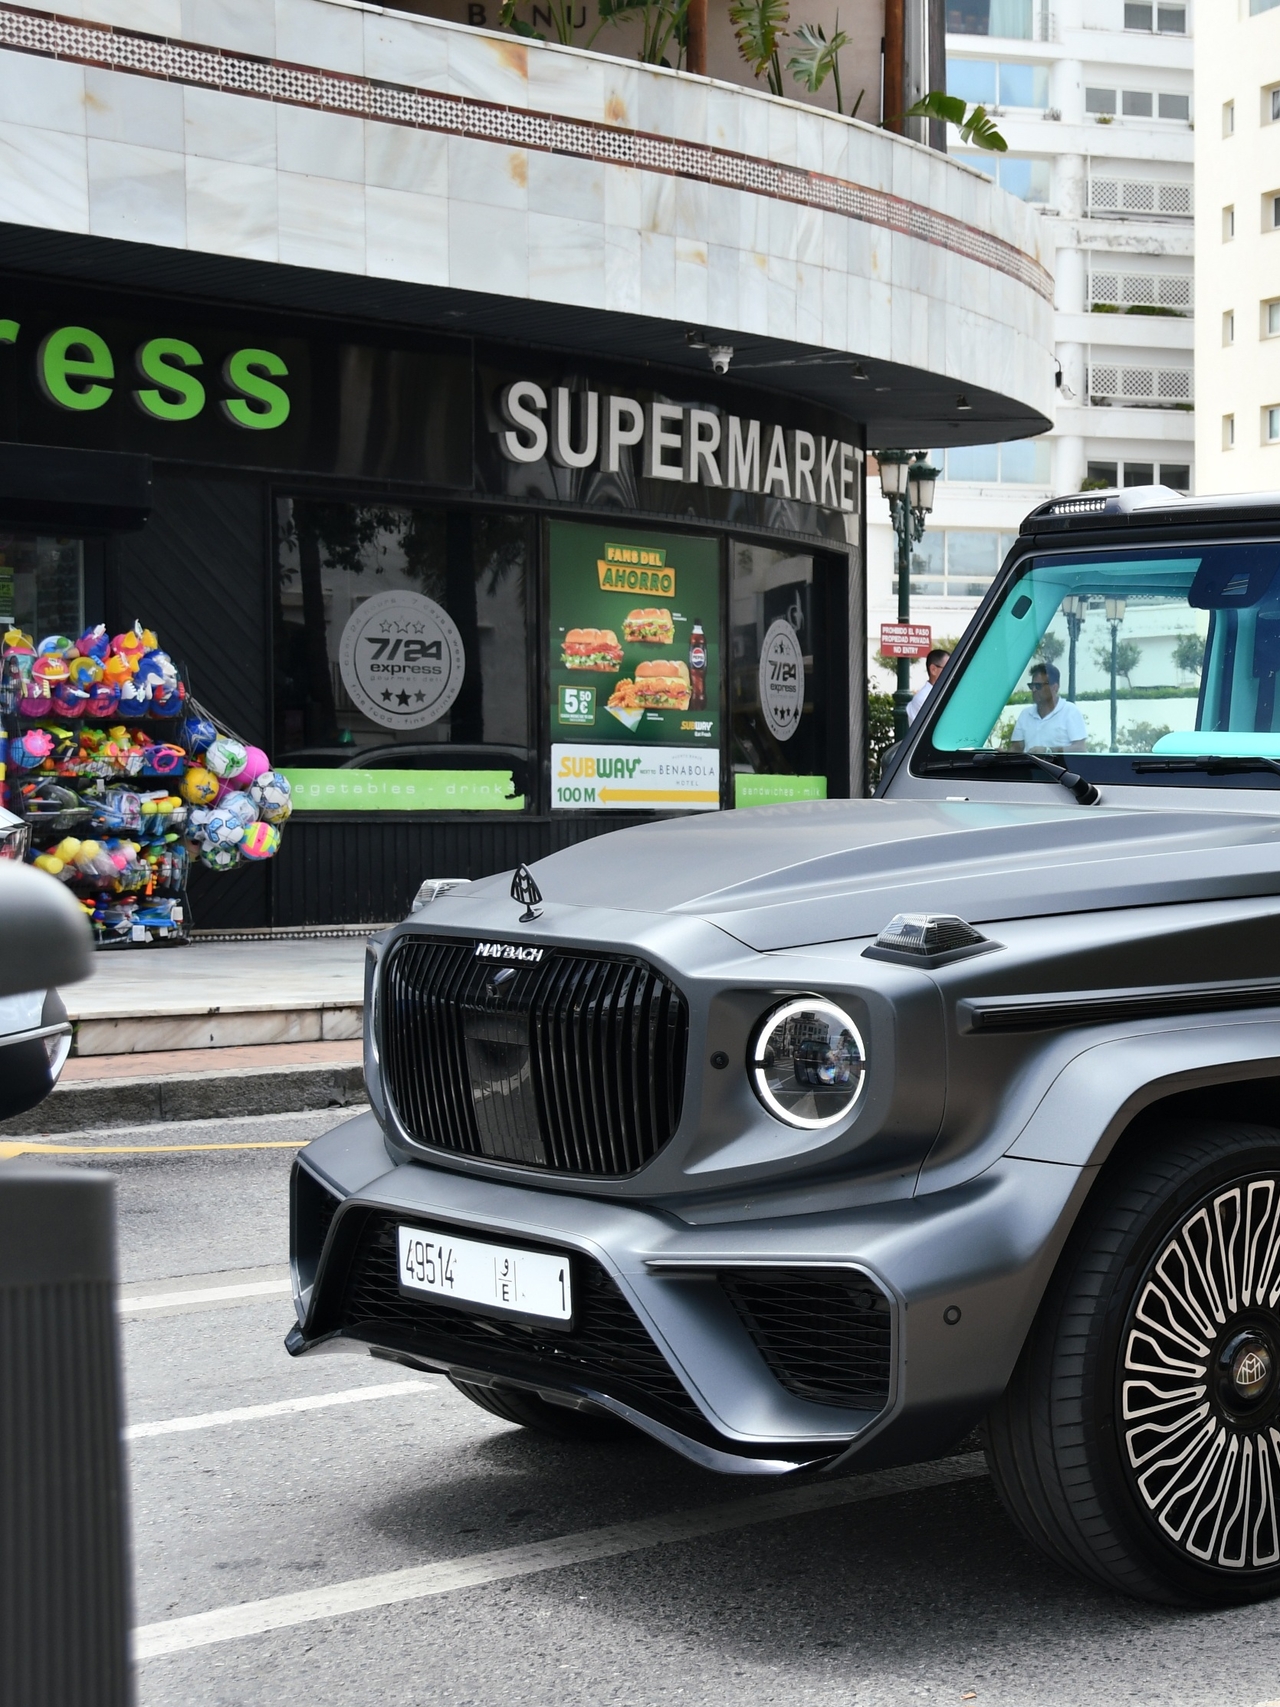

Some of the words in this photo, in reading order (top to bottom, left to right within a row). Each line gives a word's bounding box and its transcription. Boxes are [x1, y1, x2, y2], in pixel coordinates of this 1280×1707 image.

[467, 3, 586, 28] BNU
[503, 380, 864, 514] SUPERMARKET
[607, 548, 639, 564] FANS
[640, 552, 662, 566] DEL
[602, 567, 672, 592] AHORRO
[908, 627, 915, 635] EL
[915, 628, 930, 636] PASO
[364, 637, 442, 662] 7/24
[893, 646, 902, 654] NO
[902, 646, 919, 655] ENTRY
[370, 663, 442, 676] express
[768, 660, 797, 682] 7/24
[770, 683, 797, 694] express
[564, 688, 579, 714] 5
[579, 691, 592, 702] 50
[680, 721, 713, 731] SUBWAY
[557, 756, 642, 779] SUBWAY
[659, 764, 715, 776] BENABOLA
[295, 782, 416, 796] egetables
[557, 787, 582, 803] 100
[584, 788, 596, 802] M
[742, 787, 794, 797] sandwiches
[803, 787, 820, 796] milk
[475, 942, 544, 962] MAYBACH
[406, 1239, 454, 1289] 49514
[502, 1283, 510, 1302] E
[558, 1268, 566, 1311] 1
